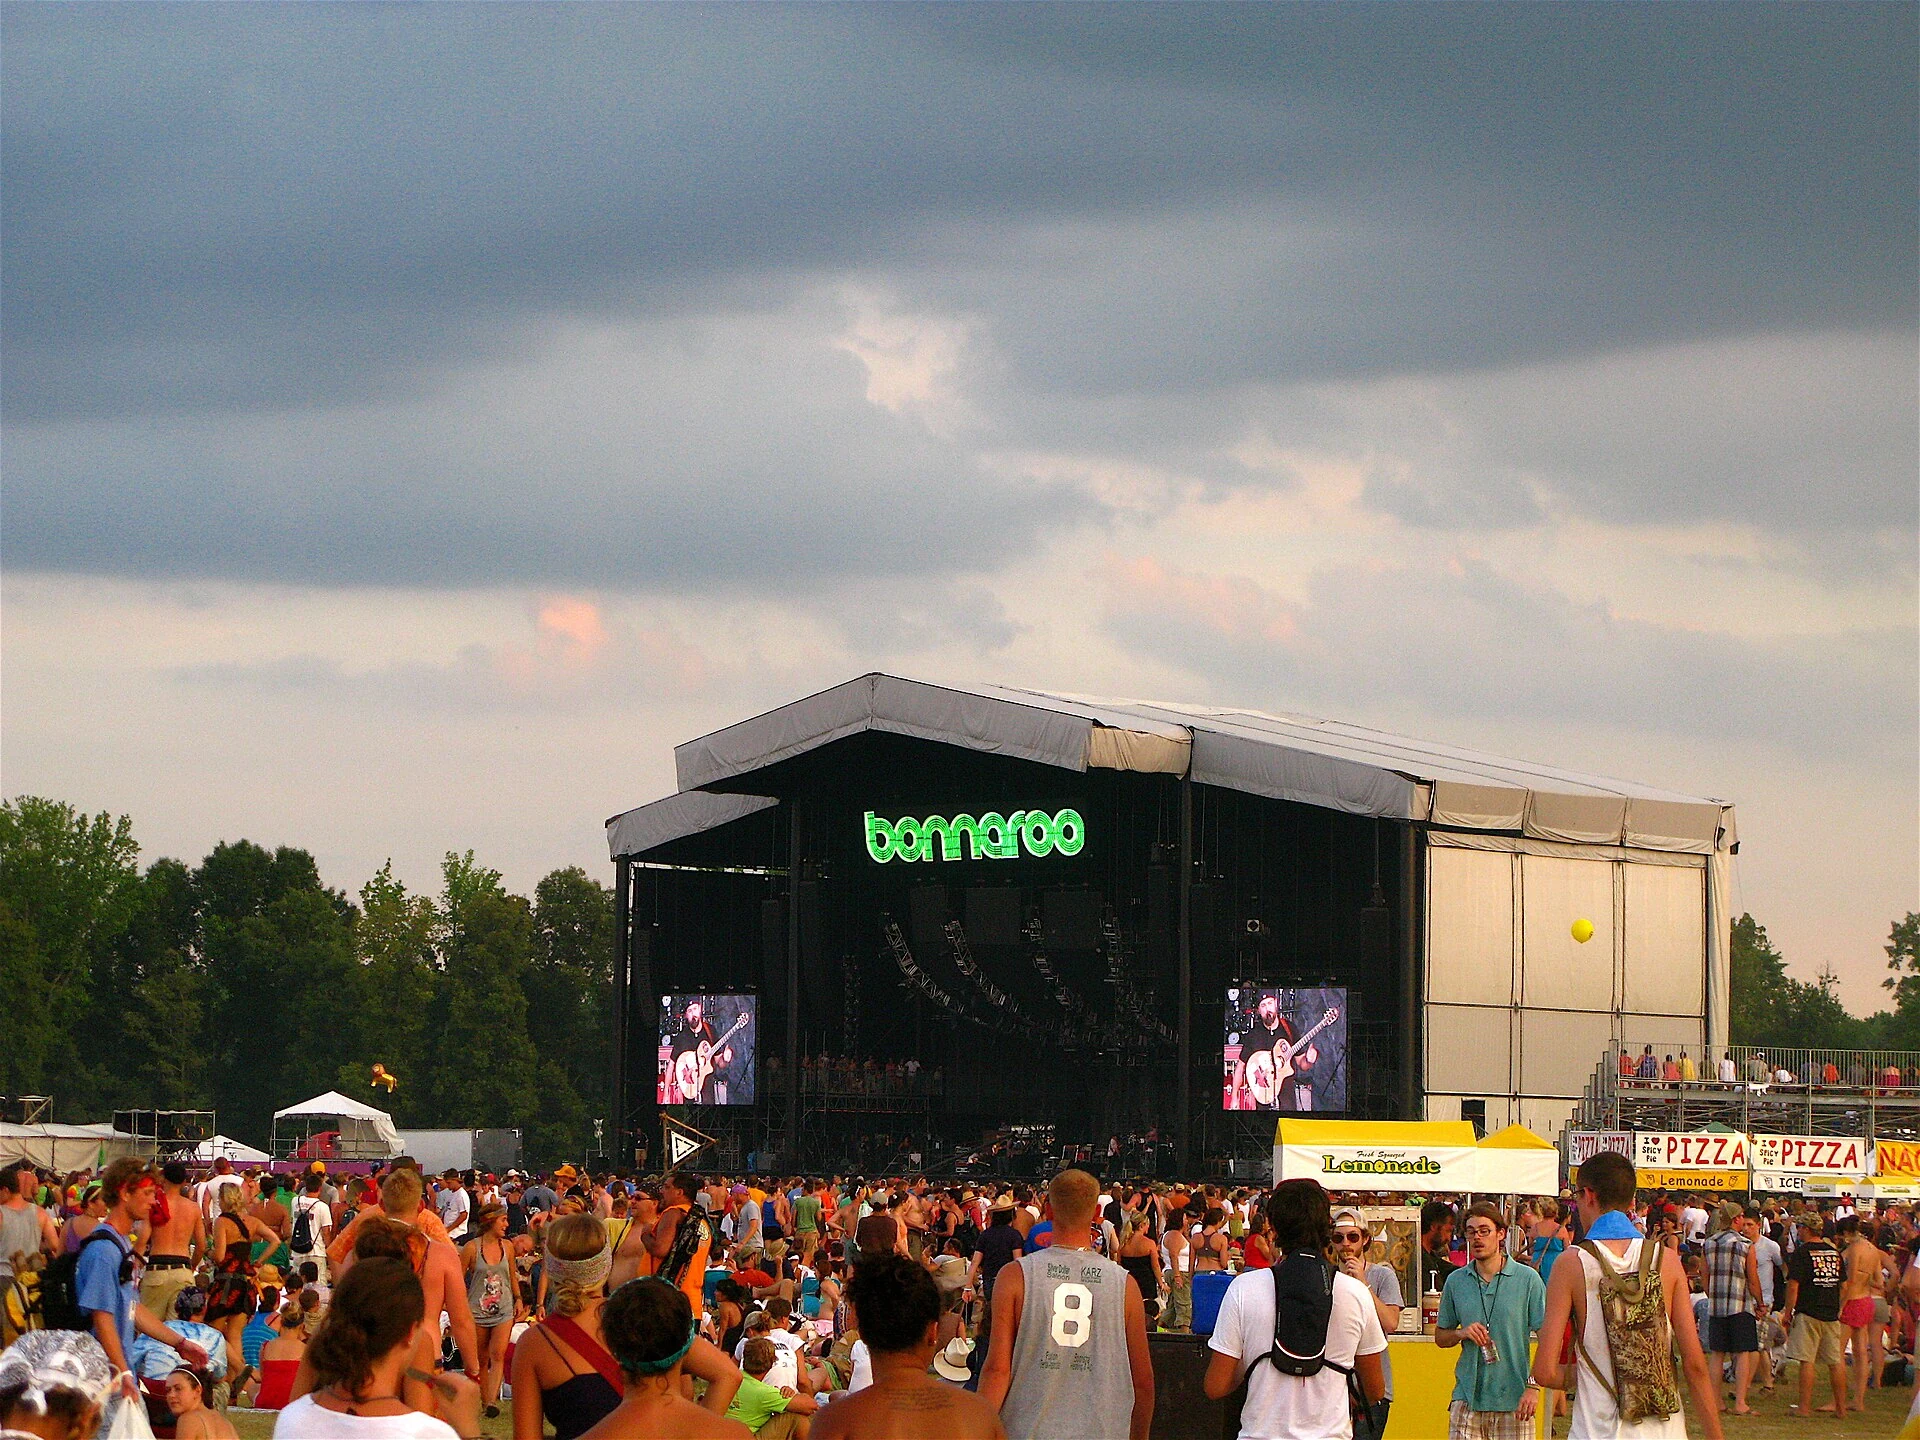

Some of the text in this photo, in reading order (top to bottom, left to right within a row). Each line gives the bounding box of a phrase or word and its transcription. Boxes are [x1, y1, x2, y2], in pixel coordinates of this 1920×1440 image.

[864, 809, 1085, 864] bonnaroo
[1356, 1150, 1375, 1158] Fresh
[1667, 1136, 1745, 1165] PIZZA
[1781, 1139, 1858, 1169] PIZZA
[1322, 1155, 1441, 1174] Lemonade
[1660, 1174, 1724, 1187] Lemonade
[1081, 1266, 1102, 1278] KARZ
[1051, 1282, 1093, 1348] 8
